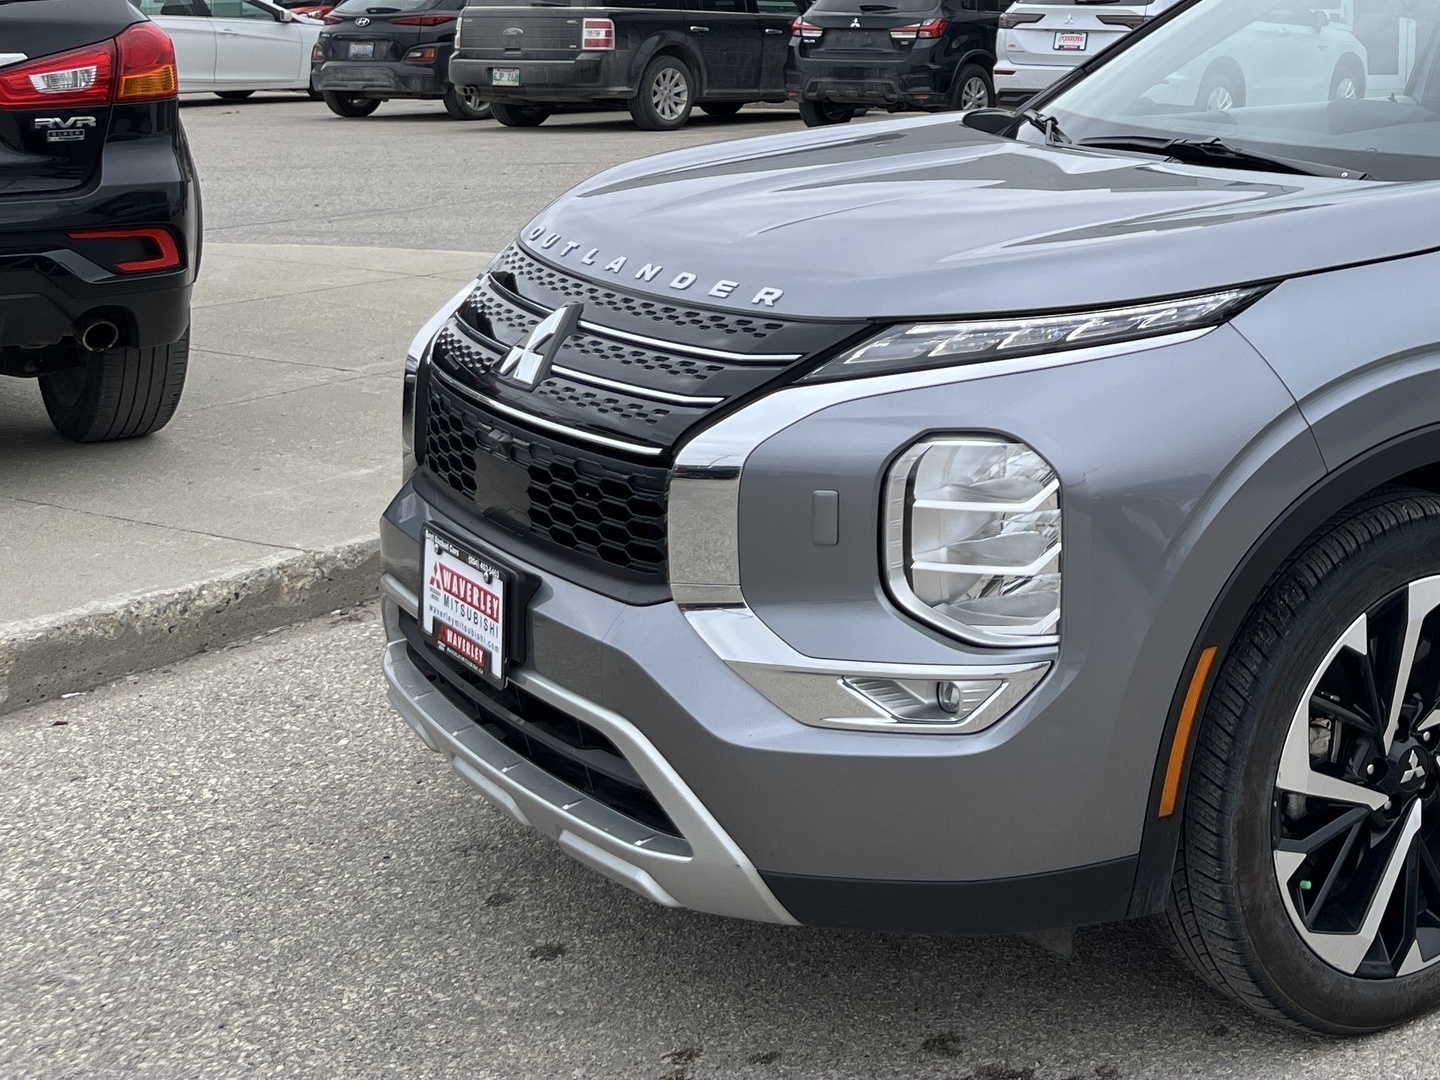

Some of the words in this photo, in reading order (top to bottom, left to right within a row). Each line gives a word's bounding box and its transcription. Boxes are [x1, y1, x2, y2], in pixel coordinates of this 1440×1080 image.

[34, 116, 97, 129] RVR
[529, 225, 784, 306] OUTLANDER
[442, 567, 499, 619] WAVERLEY
[443, 593, 499, 639] MITSUBISHI
[429, 604, 500, 653] waverleymitsubishi.com
[446, 628, 484, 663] WAVERLEY
